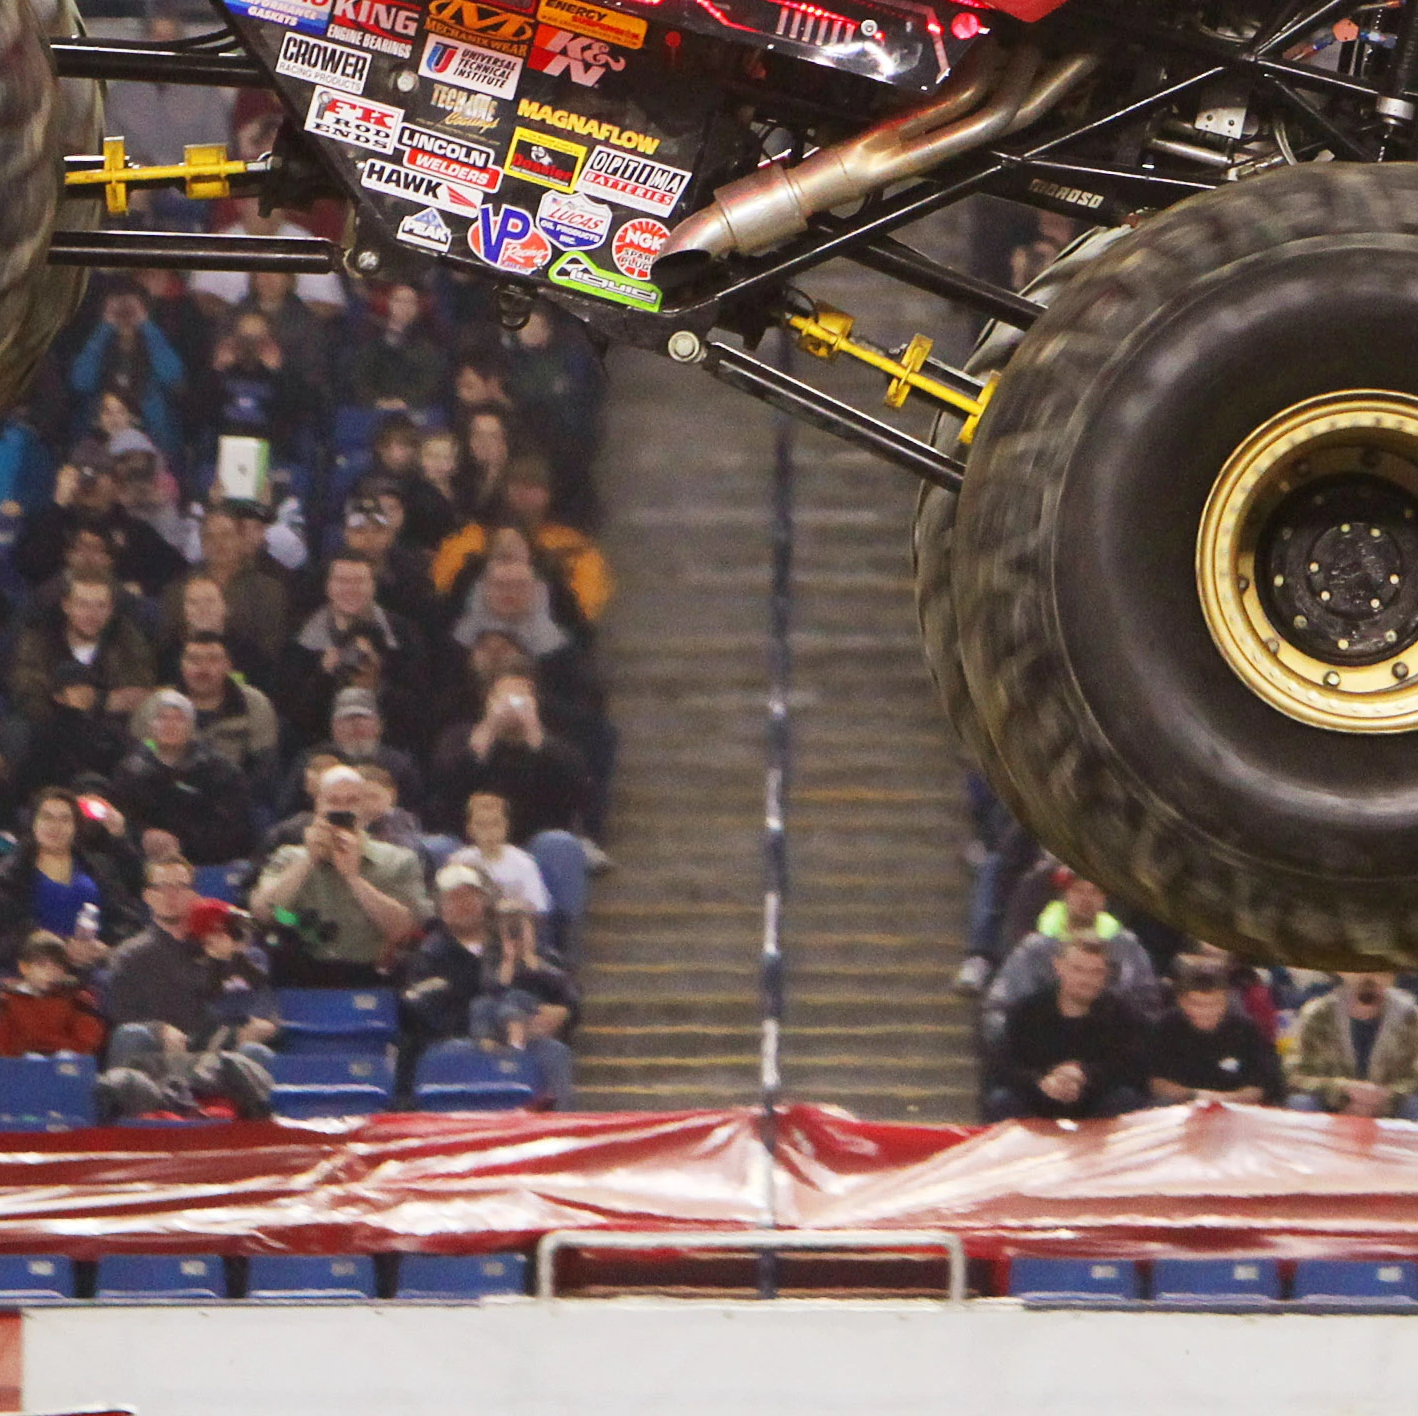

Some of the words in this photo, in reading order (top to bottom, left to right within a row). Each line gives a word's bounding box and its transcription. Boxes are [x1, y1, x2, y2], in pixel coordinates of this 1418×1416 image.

[248, 5, 299, 26] GASKETS
[327, 23, 364, 45] ENGINE
[362, 33, 413, 59] BEARINGS
[489, 39, 530, 59] WEAR
[283, 36, 367, 81] CROWER
[458, 58, 513, 80] TECHNICAL
[461, 48, 518, 72] UNIVERSAL
[279, 61, 312, 78] RACING
[313, 71, 361, 92] PRODUCTS
[453, 67, 507, 89] INSTITUTE
[313, 122, 388, 150] ENDS
[333, 116, 391, 139] ROD
[517, 98, 661, 155] MAGNAFLOW
[401, 129, 487, 167] LINCOLN
[366, 162, 444, 200] HAWK
[415, 152, 490, 186] WELDERS
[593, 151, 683, 195] OPTIMA
[584, 171, 673, 206] BATTERIES
[403, 220, 450, 243] PEAK
[548, 208, 604, 230] LUCAS
[479, 205, 532, 265] VP
[625, 230, 667, 251] NGK
[619, 255, 651, 271] PLUG
